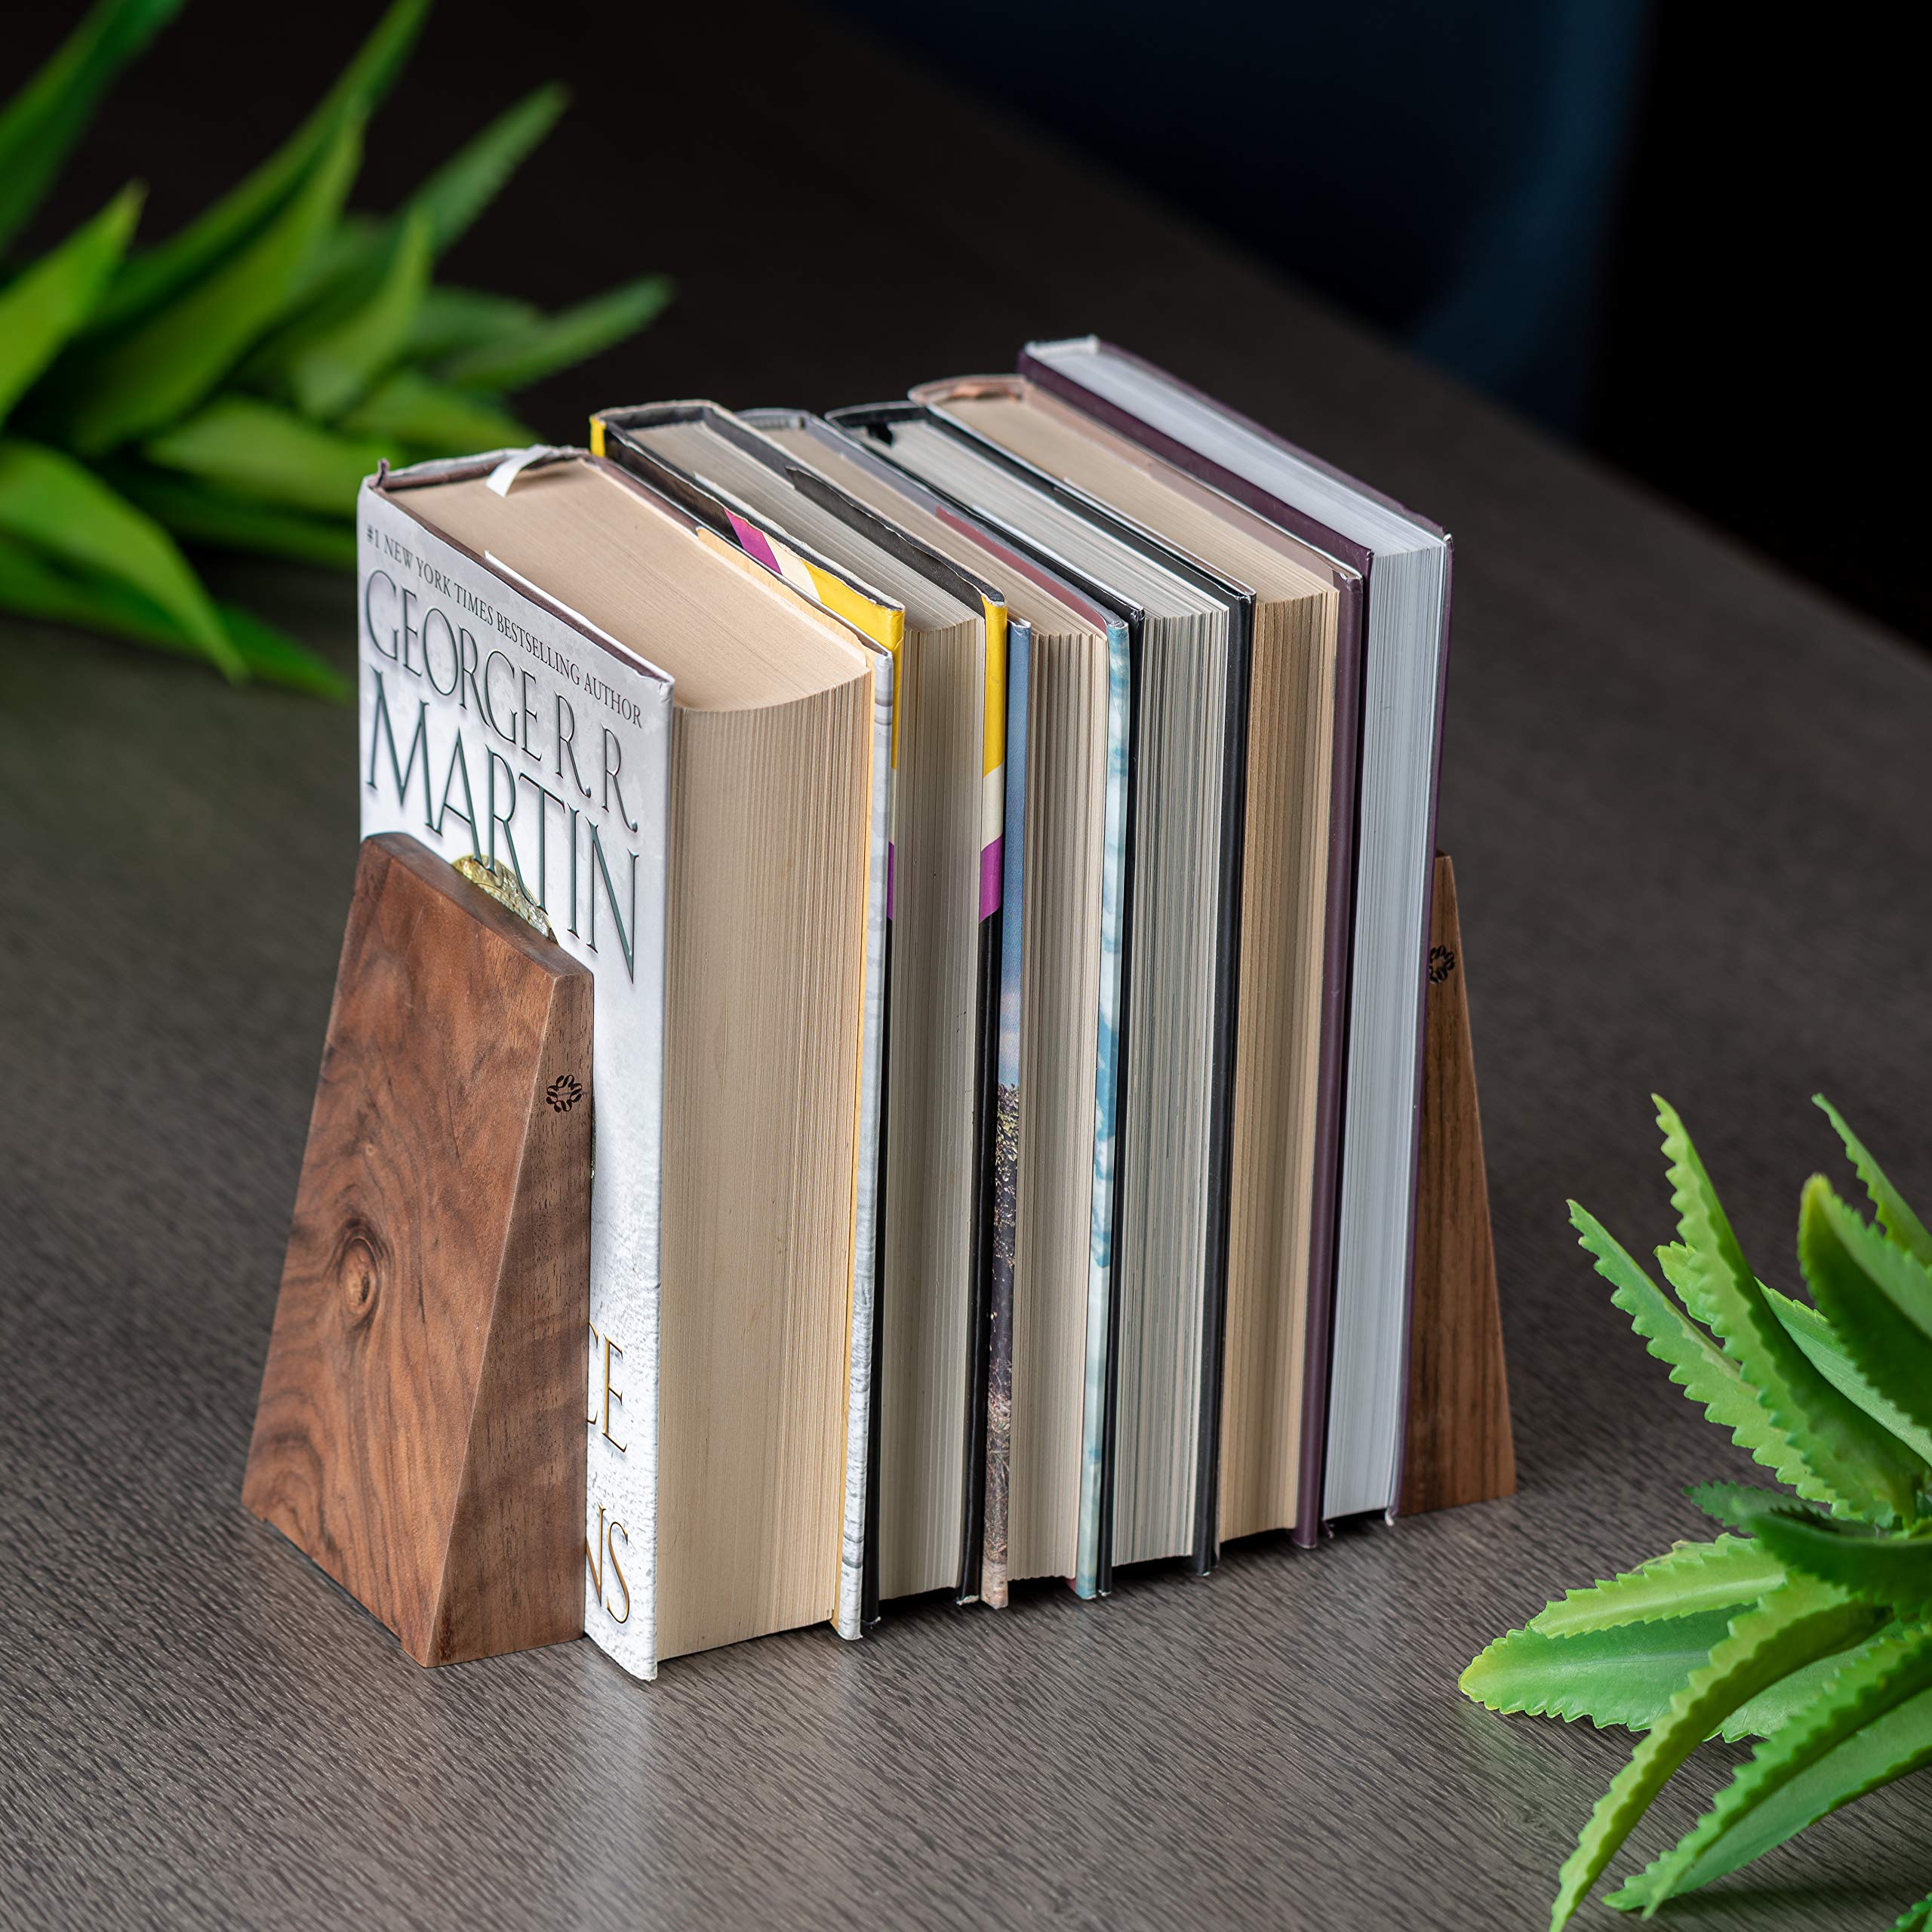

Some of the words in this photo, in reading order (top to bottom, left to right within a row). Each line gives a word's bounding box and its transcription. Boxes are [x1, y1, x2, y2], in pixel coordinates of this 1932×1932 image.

[365, 569, 543, 762] GEORGE
[366, 523, 380, 549] #1
[384, 534, 413, 571] NEW
[416, 557, 451, 598] YORK
[454, 582, 493, 626] TIMES
[496, 611, 580, 685] BESTSELLING
[583, 672, 642, 729] AUTHOR
[365, 663, 640, 985] MARTIN
